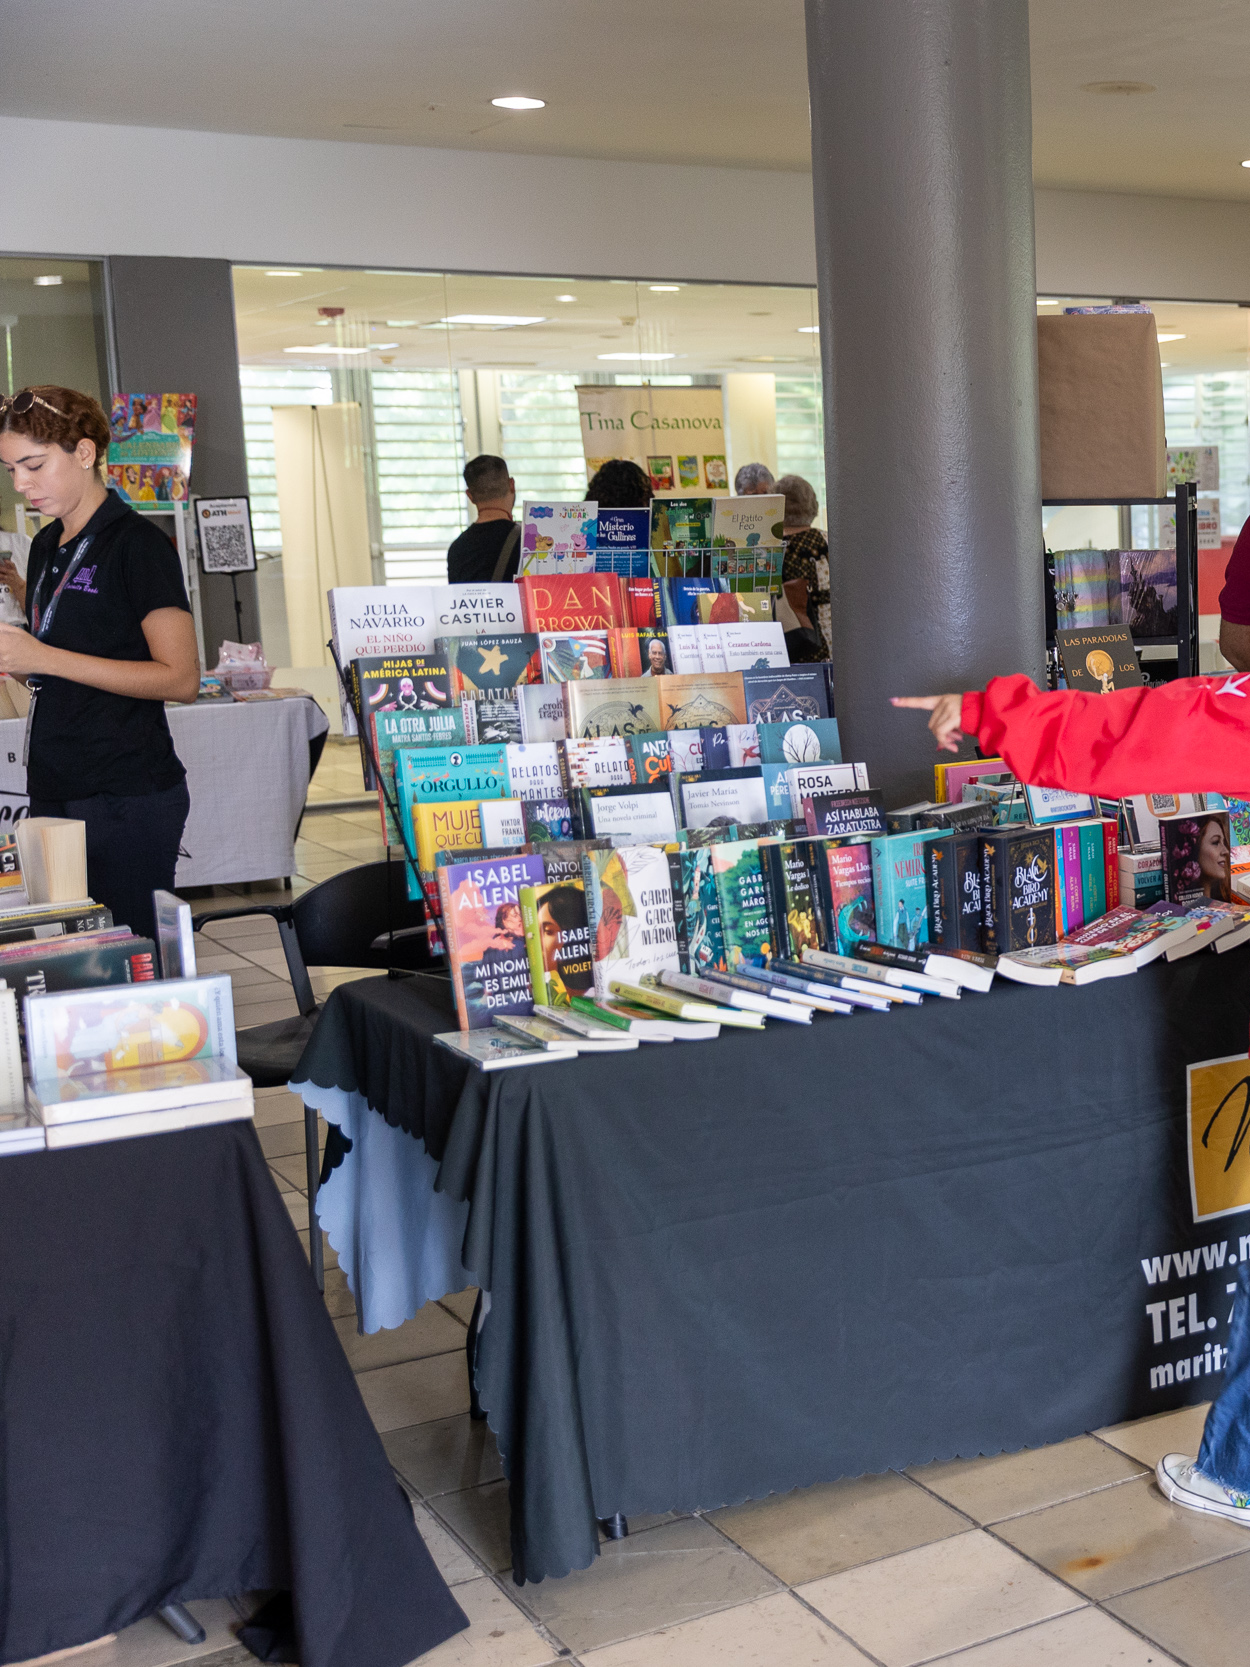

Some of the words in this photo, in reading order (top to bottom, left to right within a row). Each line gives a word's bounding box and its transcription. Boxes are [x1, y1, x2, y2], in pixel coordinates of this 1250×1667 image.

[581, 411, 625, 431] Tina
[631, 411, 722, 431] Casanova
[732, 514, 740, 523] El
[741, 514, 763, 523] Patito
[599, 520, 634, 531] Misterio
[738, 522, 755, 531] Feo
[607, 531, 636, 541] Gallinas
[450, 598, 504, 610] JAVIER
[533, 586, 612, 611] DAN
[364, 604, 409, 616] JULIA
[350, 616, 425, 629] NAVARRO
[440, 612, 516, 625] CASTILLO
[536, 615, 614, 633] BROWN
[366, 634, 381, 644] EL
[384, 632, 413, 643] NIÑO
[637, 631, 655, 639] RAFAEL
[1064, 637, 1081, 647] LAS
[1082, 633, 1128, 644] PARADOJAS
[355, 644, 377, 656] QUE
[379, 642, 426, 654] PERDIÓ
[461, 639, 478, 647] JUAN
[480, 638, 500, 646] LÓPEZ
[383, 659, 413, 669] HIJAS
[416, 658, 425, 667] DE
[1072, 669, 1084, 677] DE
[1119, 663, 1135, 672] LOS
[363, 668, 410, 679] AMÉRICA
[411, 666, 447, 677] LATINA
[385, 718, 398, 735] LA
[400, 717, 427, 734] OTRA
[429, 715, 456, 732] JULIA
[512, 764, 559, 779] RELATOS
[595, 760, 630, 774] RELATO
[421, 776, 498, 793] ORGULLO
[797, 775, 833, 790] ROSA
[512, 786, 563, 801] AMANTES
[688, 789, 710, 801] Javier
[711, 786, 738, 797] Marías
[597, 801, 617, 813] Jorge
[618, 800, 639, 811] Volpi
[689, 801, 710, 810] Tomás
[710, 799, 740, 808] Nevinson
[432, 808, 481, 832] MUJE
[597, 815, 611, 823] Una
[611, 813, 632, 822] novela
[632, 811, 657, 820] criminal
[825, 808, 840, 823] ASÍ
[841, 806, 879, 821] HABLABA
[500, 818, 521, 827] VIKTOR
[826, 819, 882, 836] ZARATUSTRA
[501, 827, 524, 836] FRANKL
[435, 834, 462, 848] QUE
[784, 859, 804, 870] Mario
[831, 853, 852, 865] Mario
[467, 863, 531, 889] ISABEL
[785, 870, 806, 882] Vargas
[833, 865, 855, 877] Vargas
[739, 873, 763, 885] GABR
[834, 877, 856, 888] Tiempos
[1137, 875, 1157, 885] VOLVER
[1022, 881, 1041, 894] BIRD
[459, 882, 543, 910] ALLEN
[640, 887, 672, 906] GABRI
[742, 896, 766, 908] MÁRQ
[1012, 887, 1049, 910] ACADEMY
[645, 907, 673, 926] GARC
[744, 920, 754, 928] EN
[557, 926, 589, 944] ISABE
[641, 925, 677, 946] MÁRQU
[745, 929, 760, 938] NOS
[553, 943, 591, 961] ALLEN
[625, 958, 651, 970] Todos
[653, 954, 664, 962] los
[475, 964, 491, 979] MI
[563, 963, 591, 975] VIOLET
[485, 979, 499, 993] ES
[487, 994, 508, 1009] DEL
[510, 990, 533, 1005] VAL
[1146, 1292, 1218, 1344] TEL.
